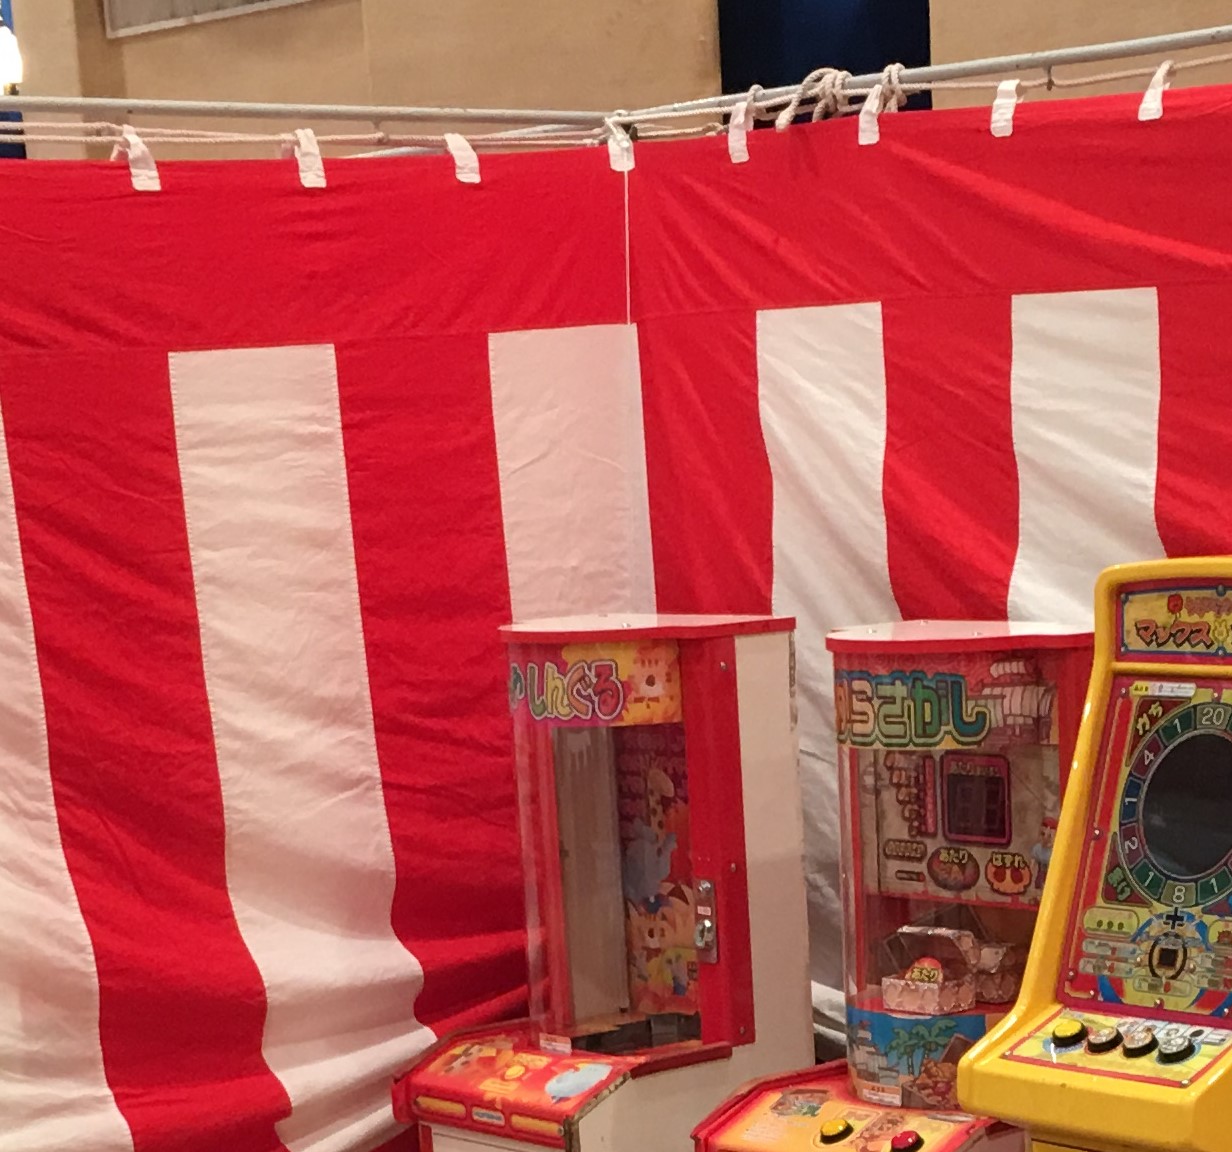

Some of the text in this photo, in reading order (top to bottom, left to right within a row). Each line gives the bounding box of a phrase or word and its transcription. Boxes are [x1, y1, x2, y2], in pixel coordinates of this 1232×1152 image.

[1135, 618, 1213, 649] マックス
[1201, 706, 1225, 726] 20
[1173, 718, 1182, 733] 1
[1143, 749, 1155, 766] 4
[1124, 836, 1139, 854] 2
[1144, 871, 1155, 887] 1
[1208, 877, 1219, 894] 1
[1172, 885, 1186, 903] 8
